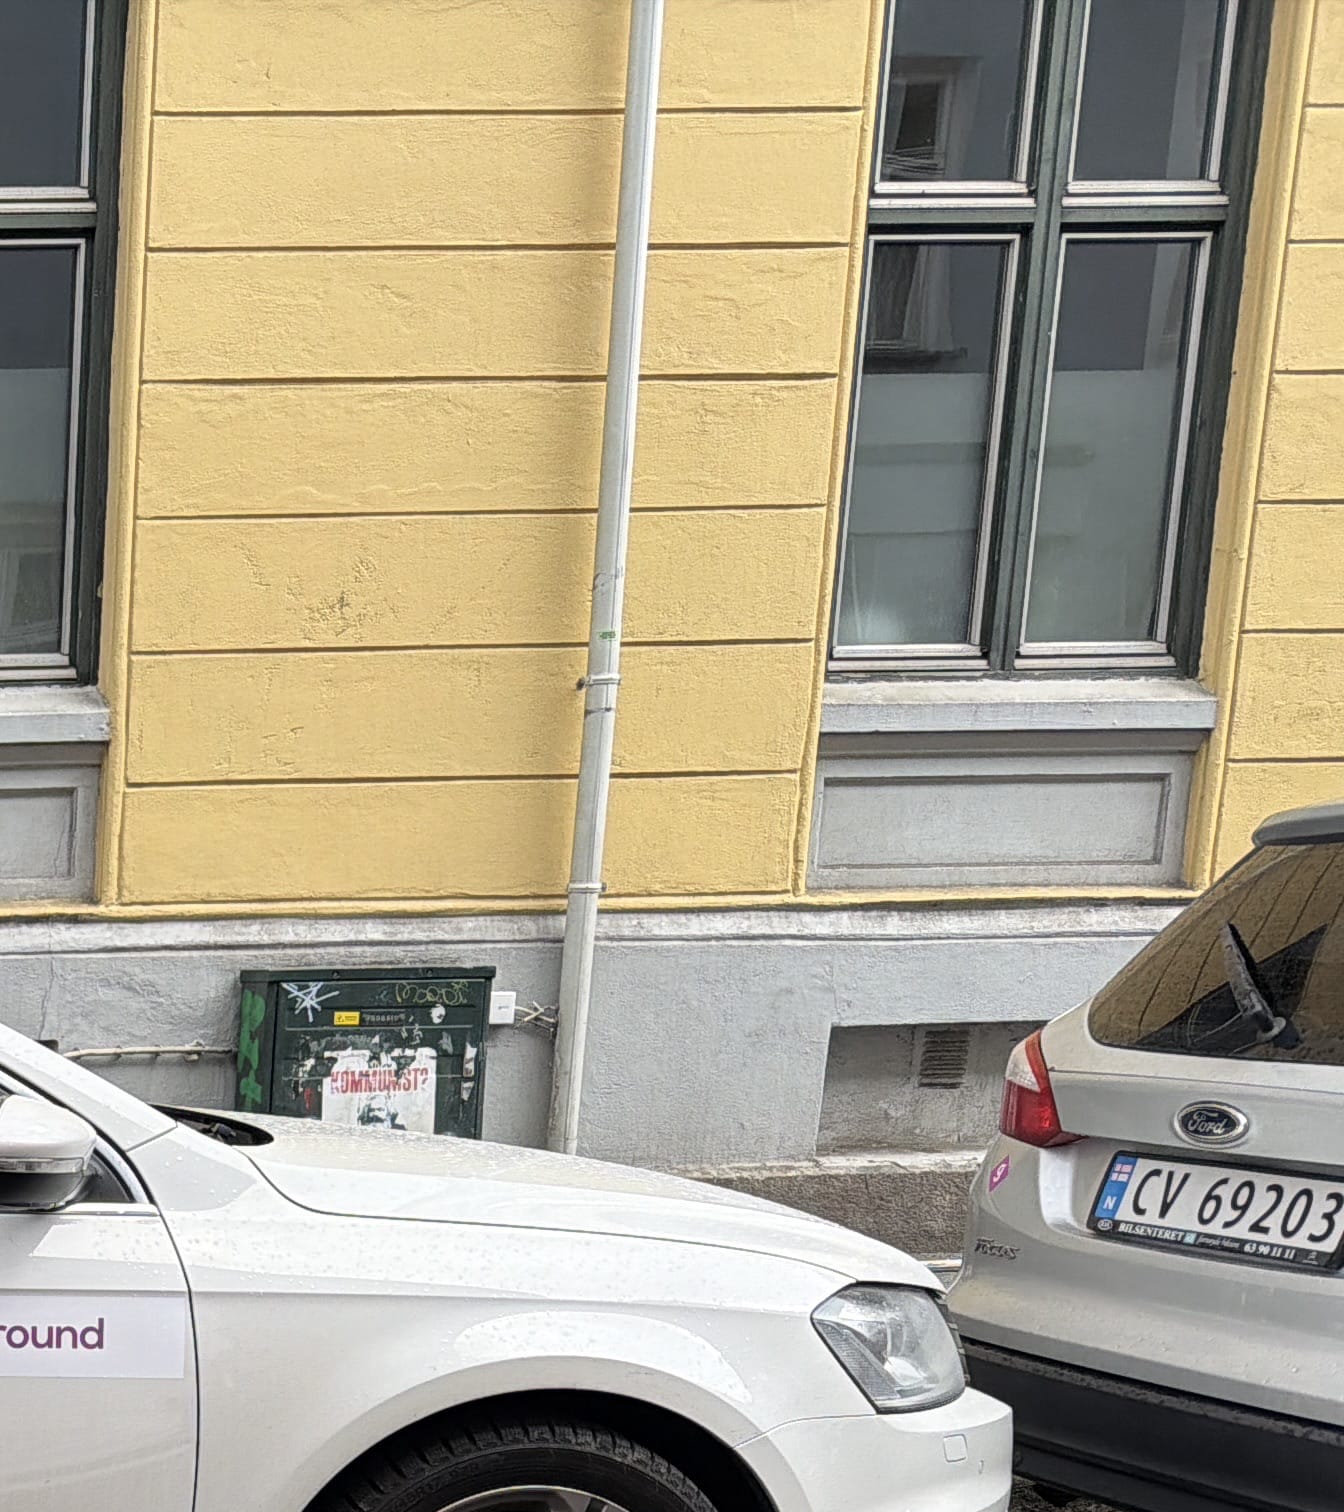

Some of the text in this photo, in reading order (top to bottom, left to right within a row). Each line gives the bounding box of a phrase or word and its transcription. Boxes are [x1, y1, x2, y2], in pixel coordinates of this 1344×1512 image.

[1187, 1110, 1228, 1134] Ford
[1102, 1195, 1117, 1210] N
[1131, 1167, 1344, 1243] CV 69203
[1117, 1221, 1185, 1243] BILSENTERET
